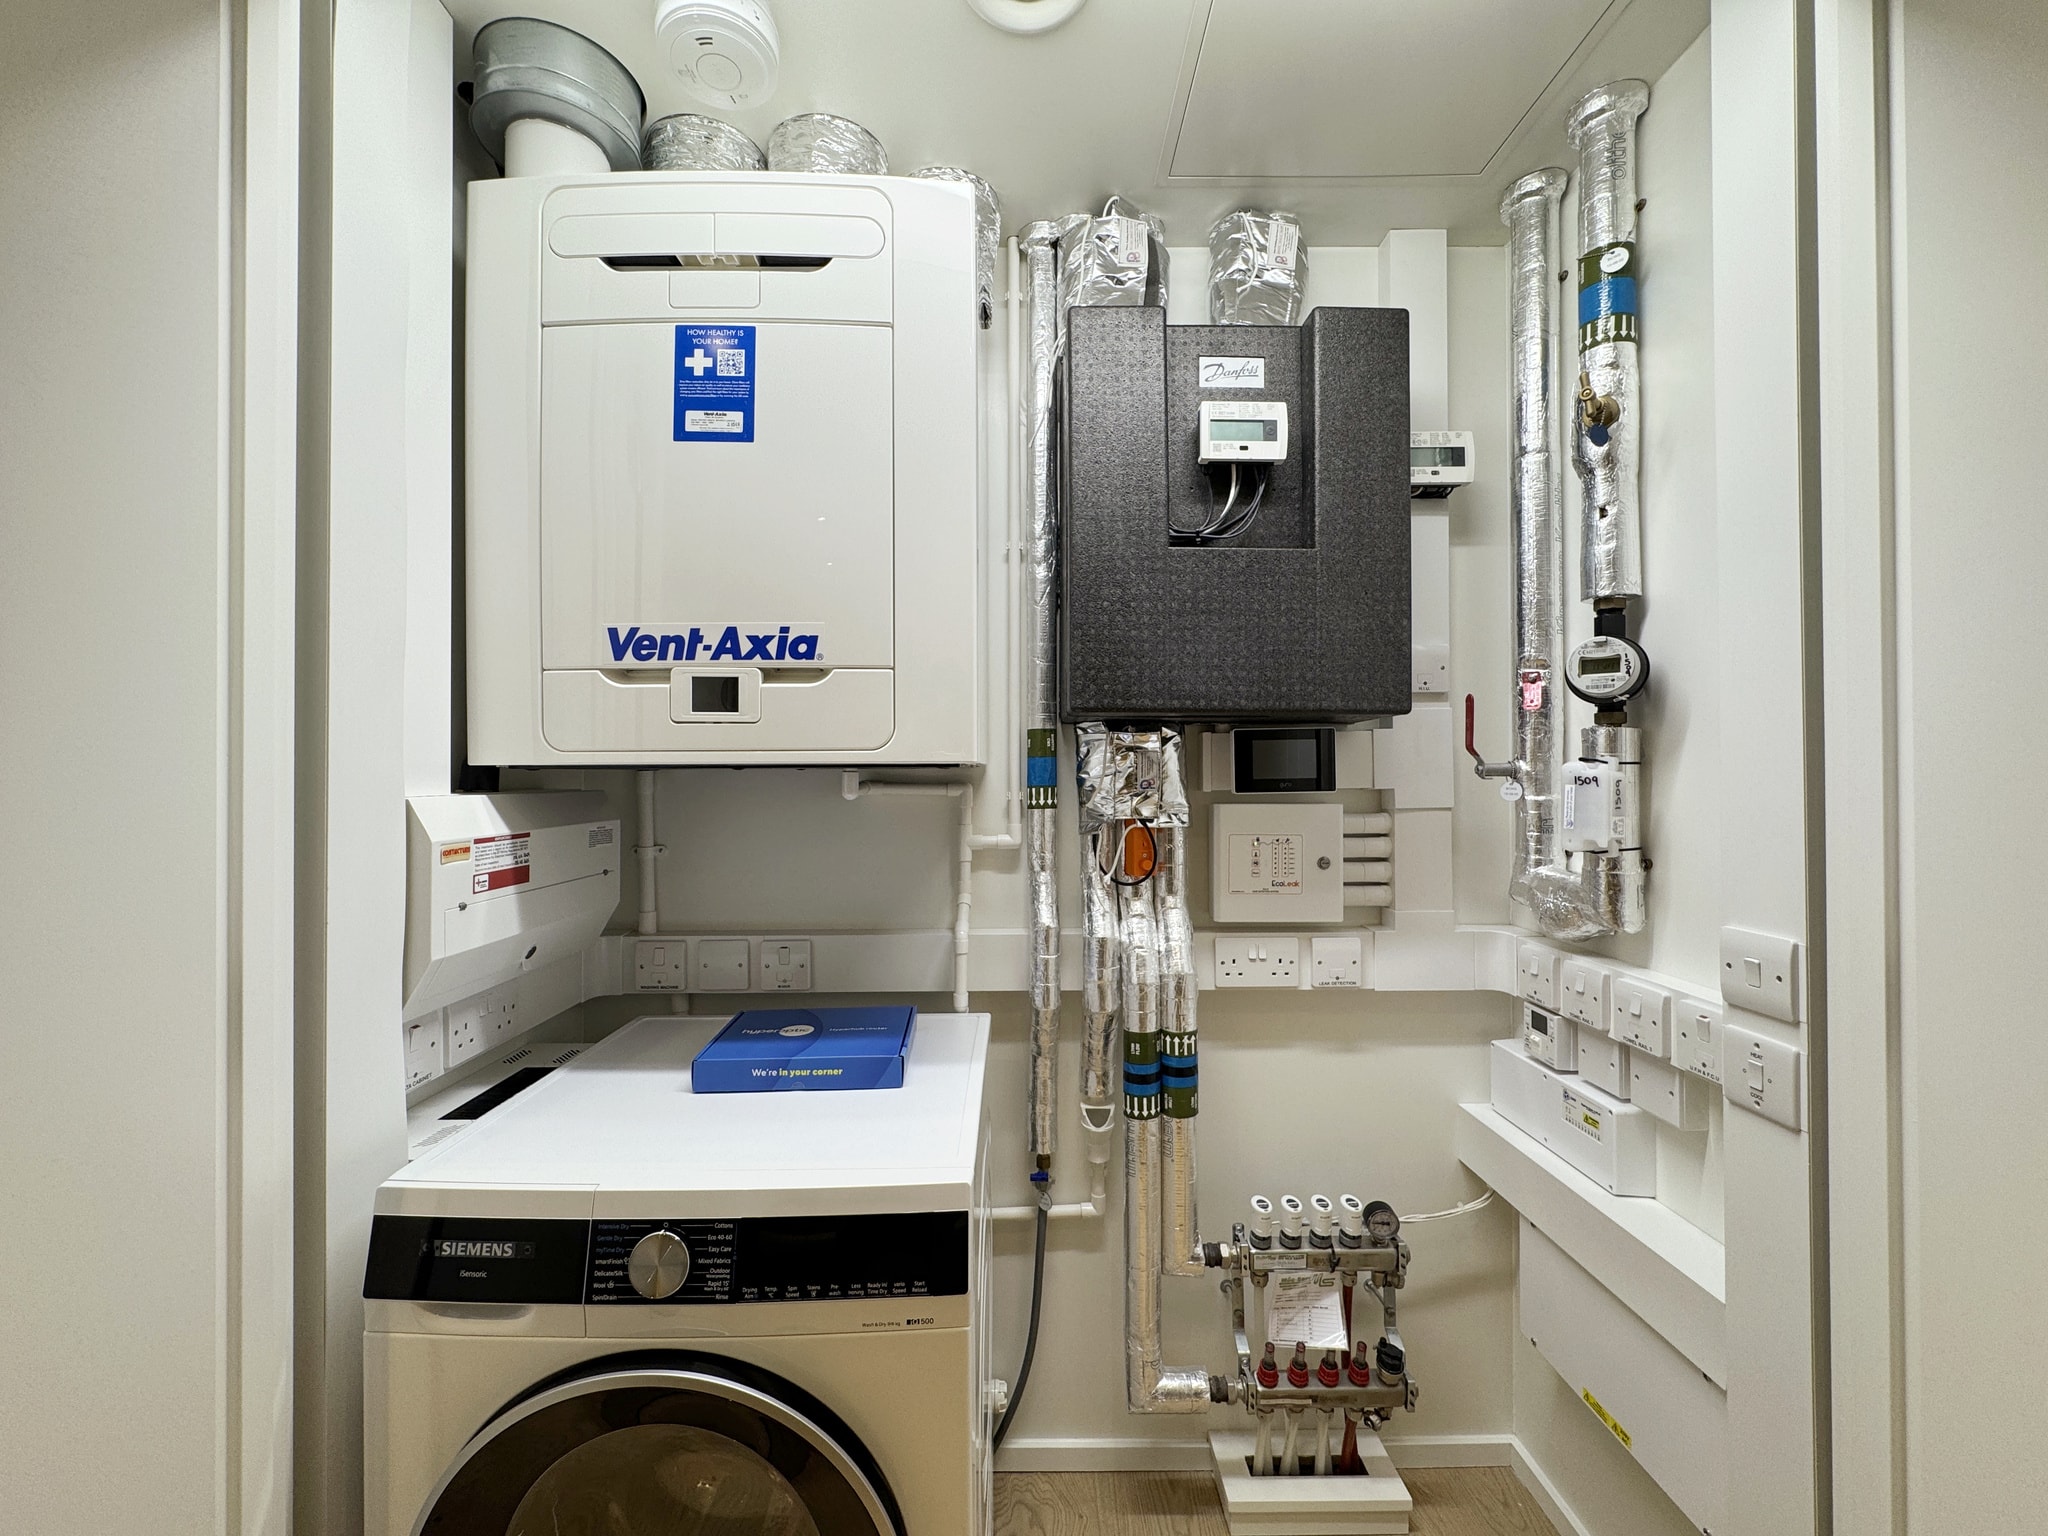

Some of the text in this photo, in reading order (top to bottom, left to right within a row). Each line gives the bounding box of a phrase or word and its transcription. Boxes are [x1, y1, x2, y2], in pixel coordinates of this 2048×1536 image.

[1203, 360, 1259, 382] Danfoss
[607, 626, 819, 662] Vent-Axia
[1574, 776, 1599, 787] 1509
[790, 1069, 810, 1077] your
[1750, 1092, 1764, 1102] COOL
[441, 1242, 513, 1257] SIEMENS
[460, 1270, 487, 1278] iSensoric
